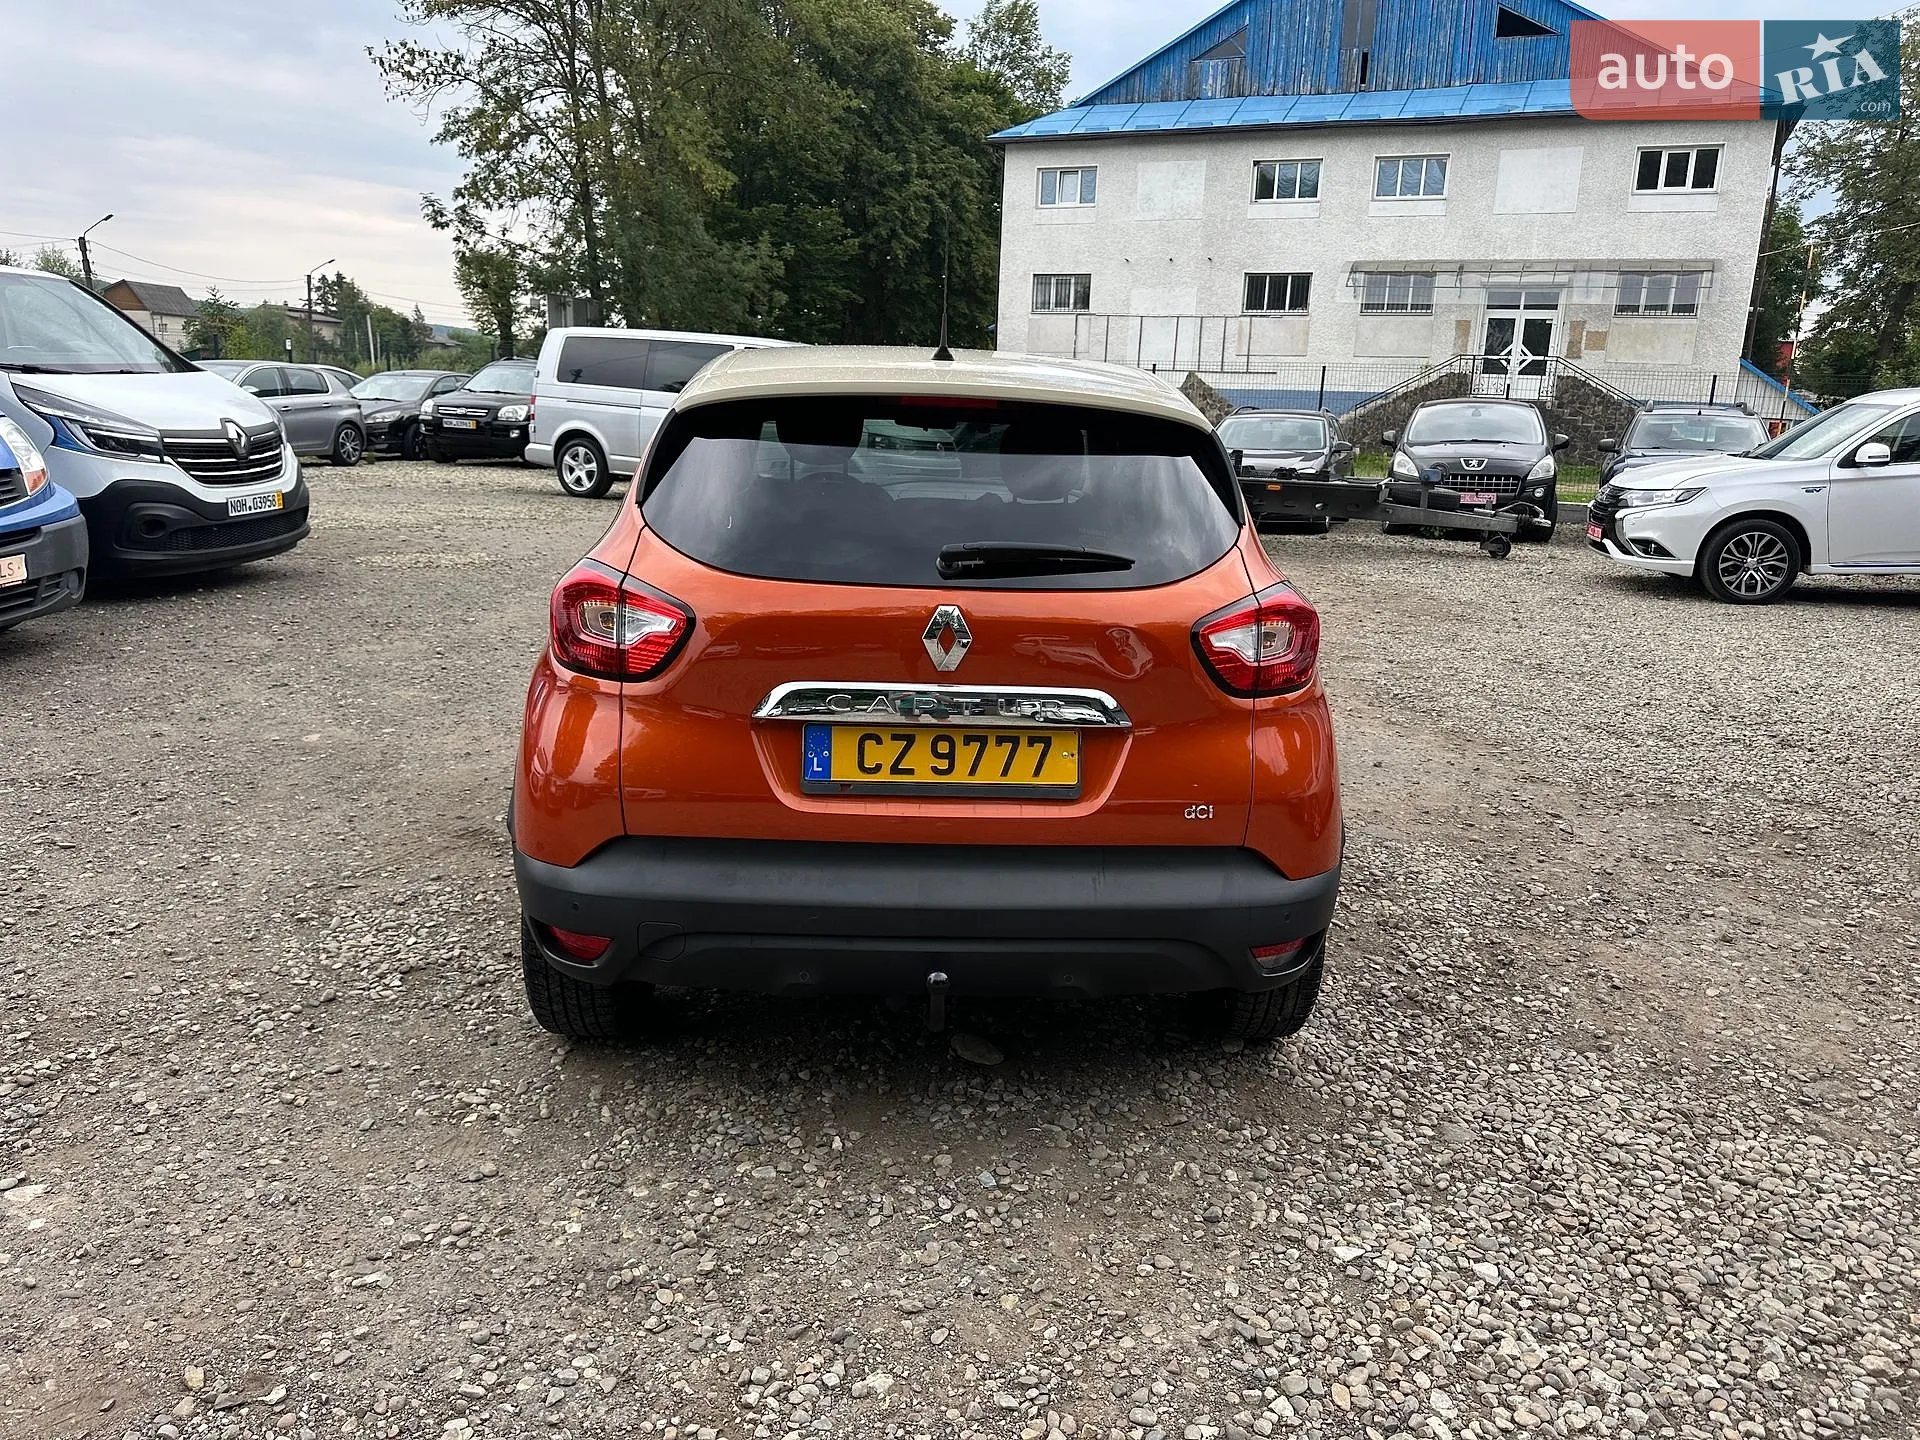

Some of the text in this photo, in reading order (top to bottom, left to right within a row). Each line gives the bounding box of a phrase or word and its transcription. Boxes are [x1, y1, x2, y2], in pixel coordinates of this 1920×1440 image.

[825, 694, 1065, 720] CAPTUR
[813, 757, 823, 772] L
[857, 732, 1053, 778] CZ 9777
